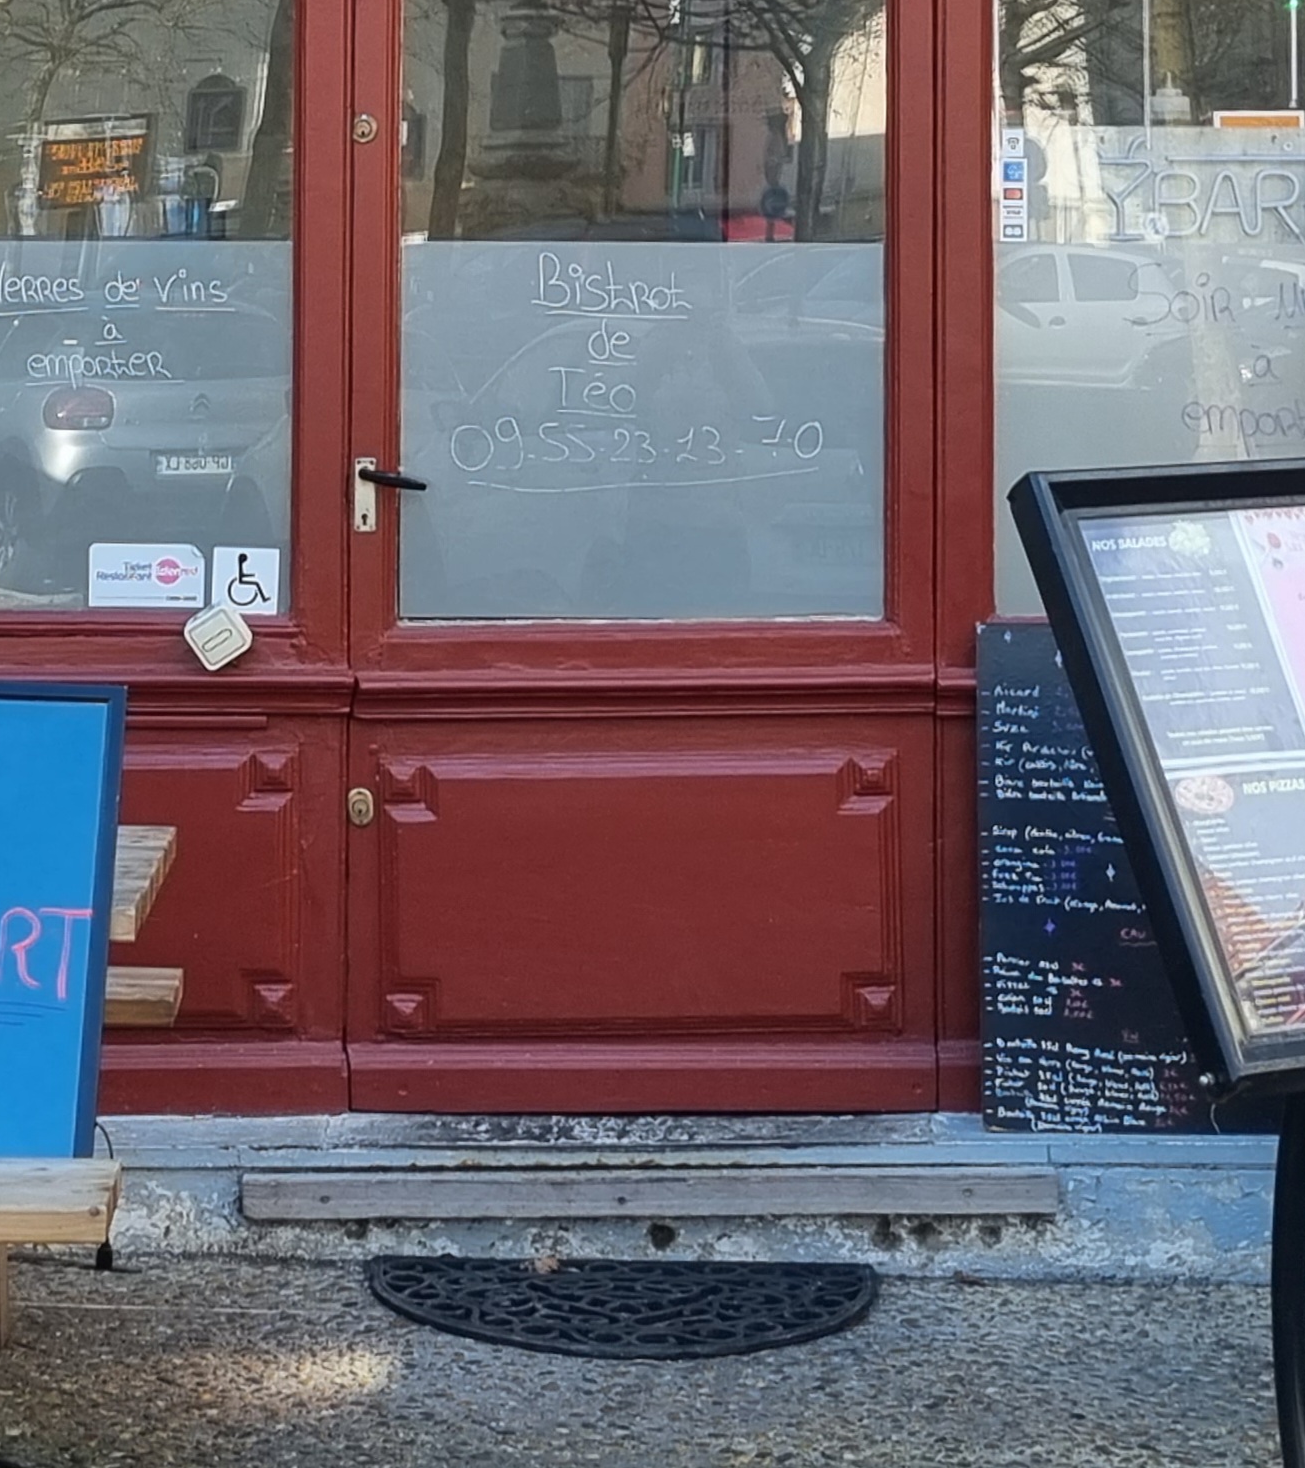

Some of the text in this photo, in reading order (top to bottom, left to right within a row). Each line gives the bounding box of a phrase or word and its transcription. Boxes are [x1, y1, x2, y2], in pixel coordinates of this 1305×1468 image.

[105, 271, 140, 302] de
[531, 252, 693, 312] Bistrot
[101, 315, 123, 339] à
[587, 319, 635, 360] de
[27, 350, 172, 389] emporter
[549, 366, 637, 411] Téo
[1092, 538, 1117, 551] NOS
[123, 562, 152, 572] Ticket
[1243, 780, 1267, 795] NOS
